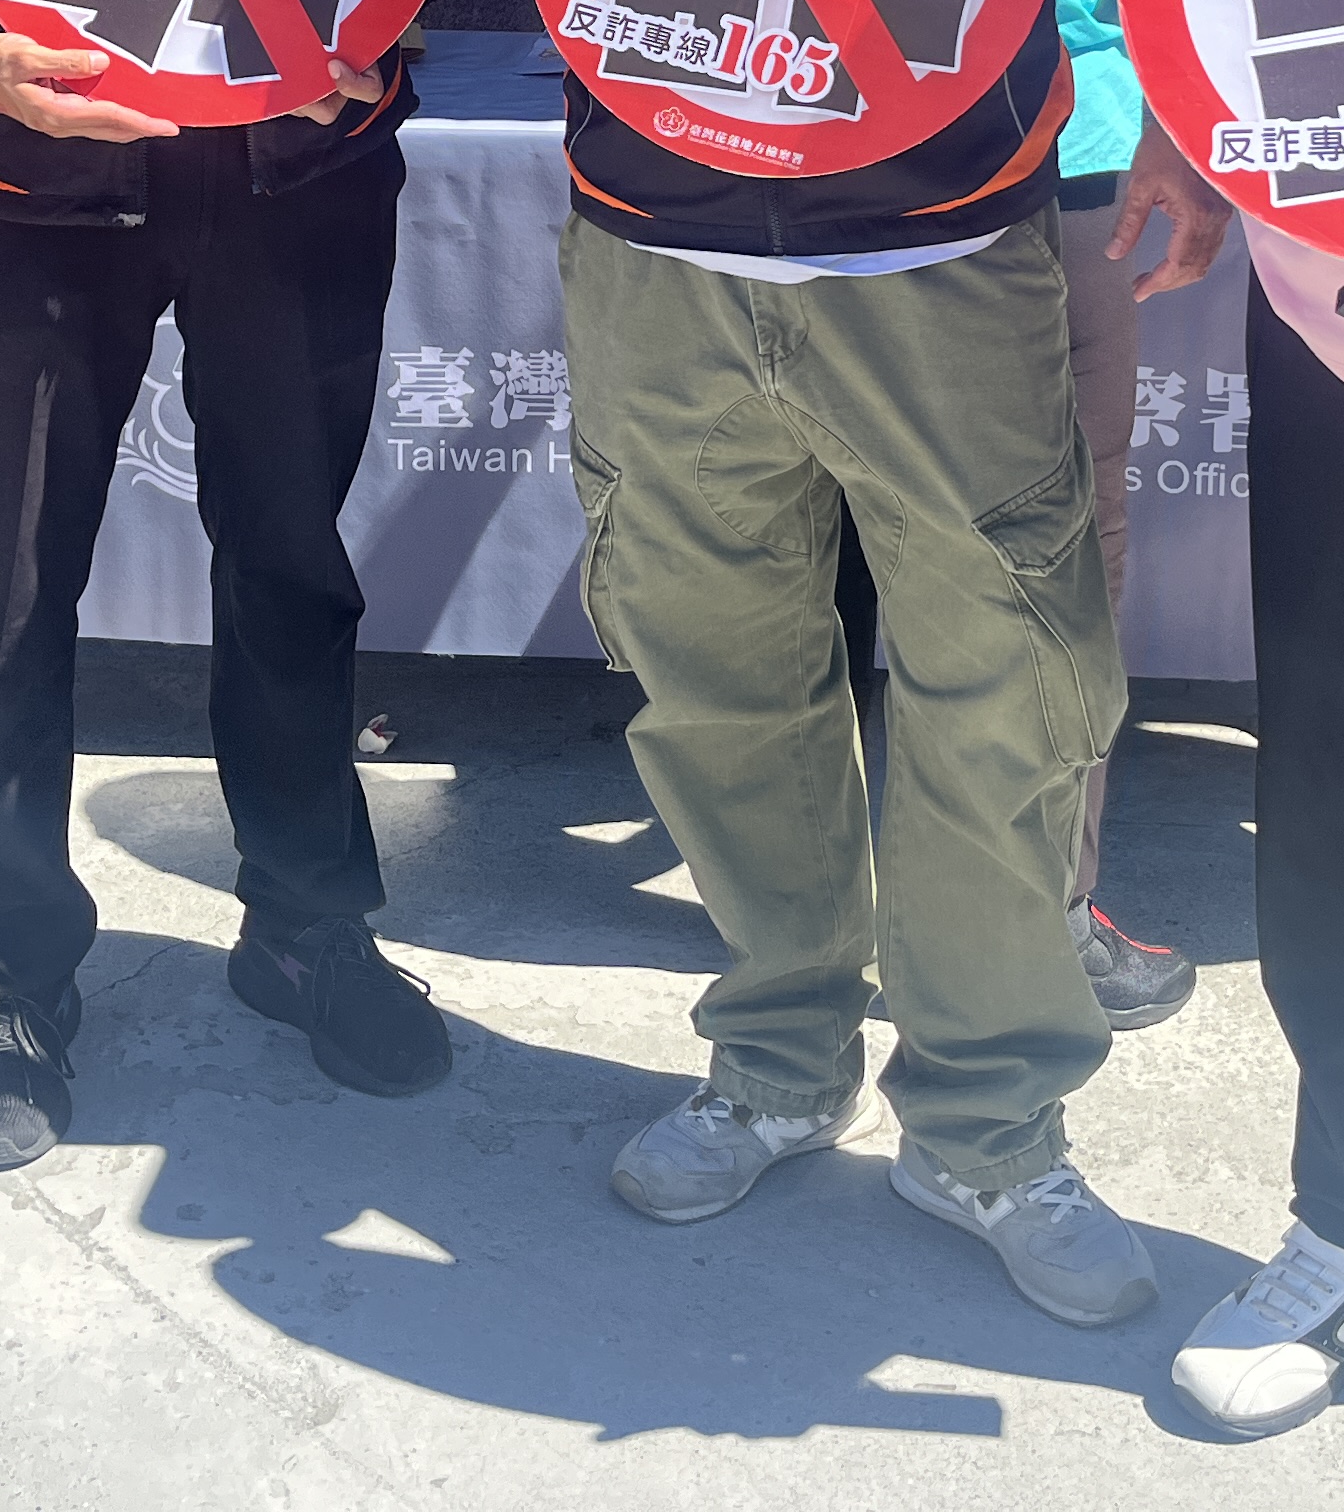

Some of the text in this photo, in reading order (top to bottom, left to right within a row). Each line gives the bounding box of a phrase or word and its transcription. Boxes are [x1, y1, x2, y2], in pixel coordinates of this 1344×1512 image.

[567, 0, 836, 99] 反詐專線165
[387, 439, 532, 473] Taiwan
[1157, 459, 1252, 498] Offic
